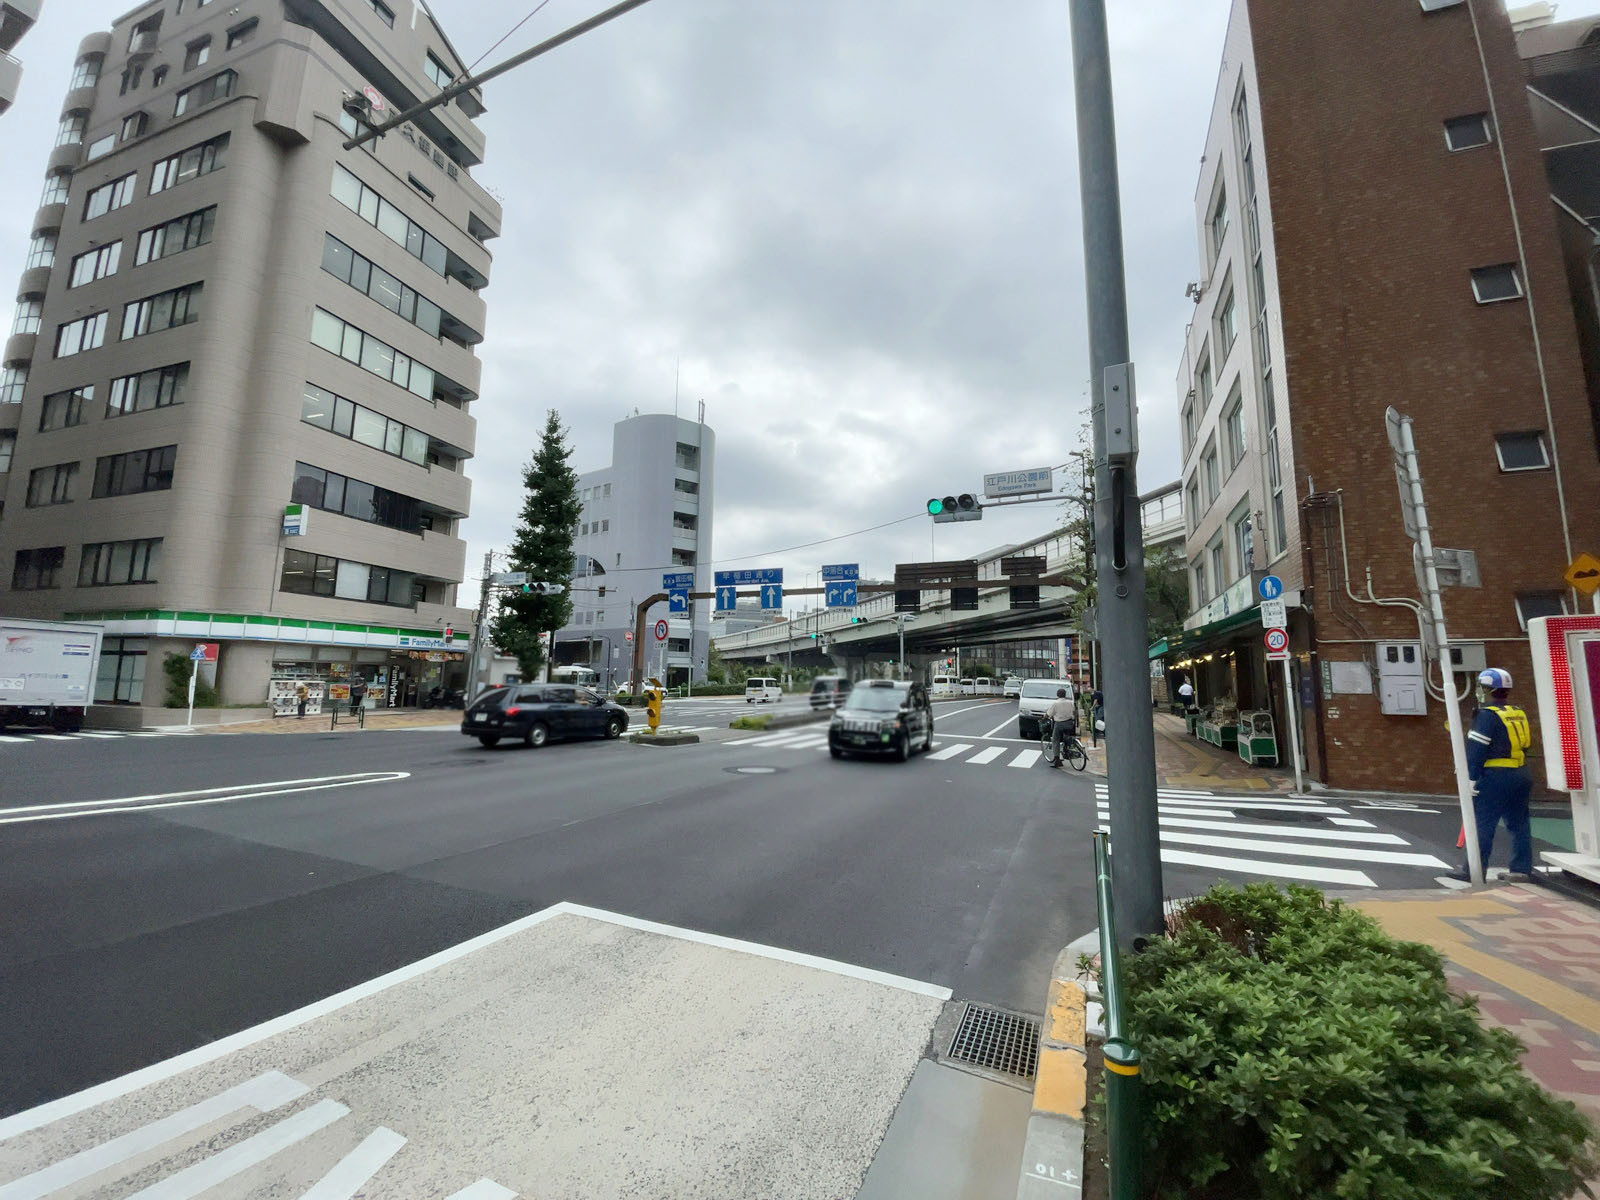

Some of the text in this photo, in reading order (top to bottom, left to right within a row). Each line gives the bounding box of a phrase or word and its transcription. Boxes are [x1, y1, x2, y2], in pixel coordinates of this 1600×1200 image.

[987, 471, 1049, 486] 江戸川公園前
[412, 639, 449, 648] FamilyMa
[1269, 634, 1283, 646] 20
[389, 665, 400, 707] FamilyMart
